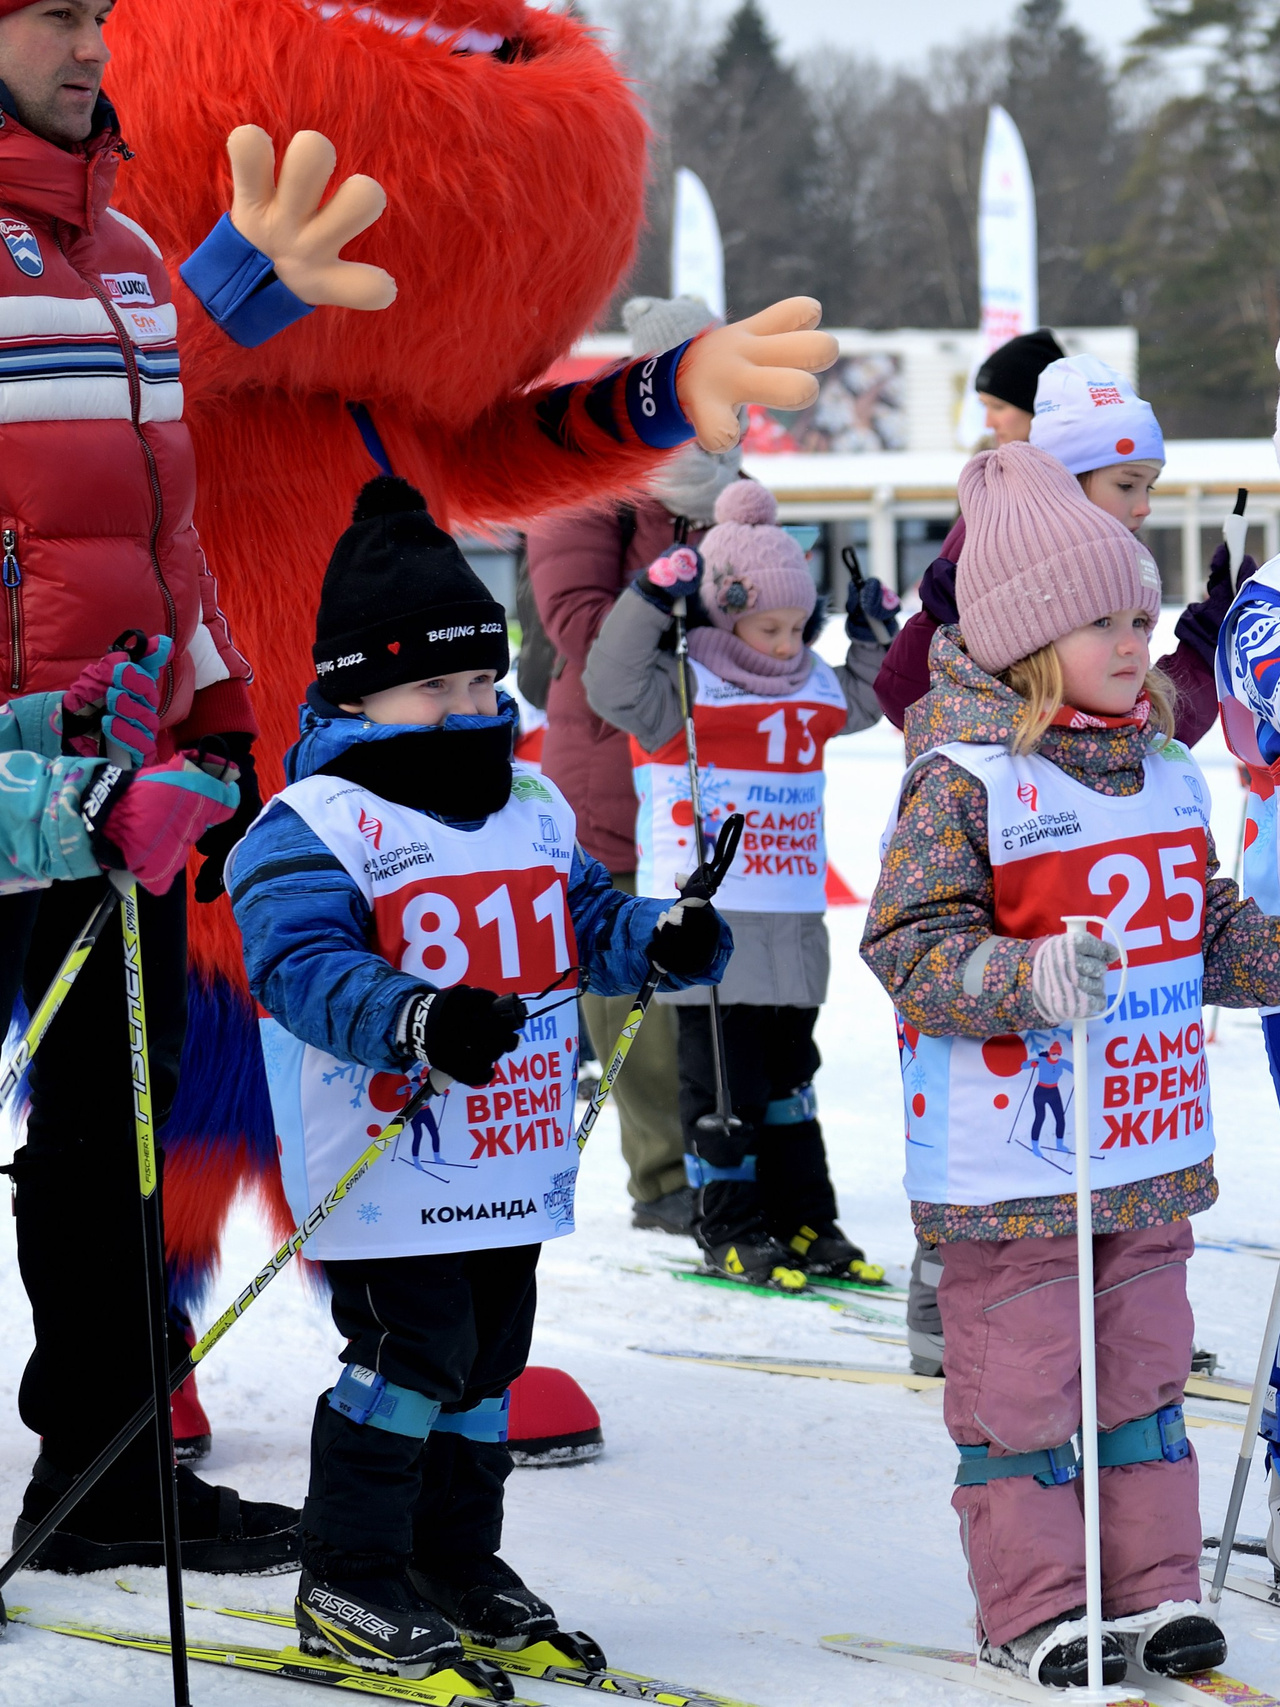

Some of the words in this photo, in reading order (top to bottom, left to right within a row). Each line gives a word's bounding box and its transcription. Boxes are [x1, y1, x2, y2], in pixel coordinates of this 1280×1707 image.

[639, 354, 658, 417] OZO
[426, 625, 475, 643] BEIJING
[480, 622, 503, 634] 2022
[337, 652, 367, 669] 2022
[756, 707, 819, 766] 13
[747, 784, 817, 805] ЛЫЖНЯ
[744, 809, 818, 831] САМОЕ
[1001, 817, 1038, 838] ФОНД
[379, 840, 430, 867] БОРЬБЫ
[743, 832, 818, 852] ВРЕМЯ
[1003, 839, 1014, 851] С
[742, 854, 818, 876] ЖИТЬ
[1087, 844, 1204, 952] 25
[401, 879, 570, 990] 811
[411, 993, 437, 1065] FISCHE
[606, 1049, 625, 1086] SPRINT
[1102, 1060, 1207, 1110] ВРЕМЯ
[466, 1082, 562, 1124] ВРЕМЯ
[468, 1117, 564, 1161] ЖИТЬ
[1099, 1097, 1205, 1150] ЖИТЬ
[345, 1160, 370, 1194] SPRINT
[420, 1197, 538, 1225] КОМАНДА
[1066, 1464, 1077, 1479] 25
[308, 1587, 400, 1643] FISCHER
